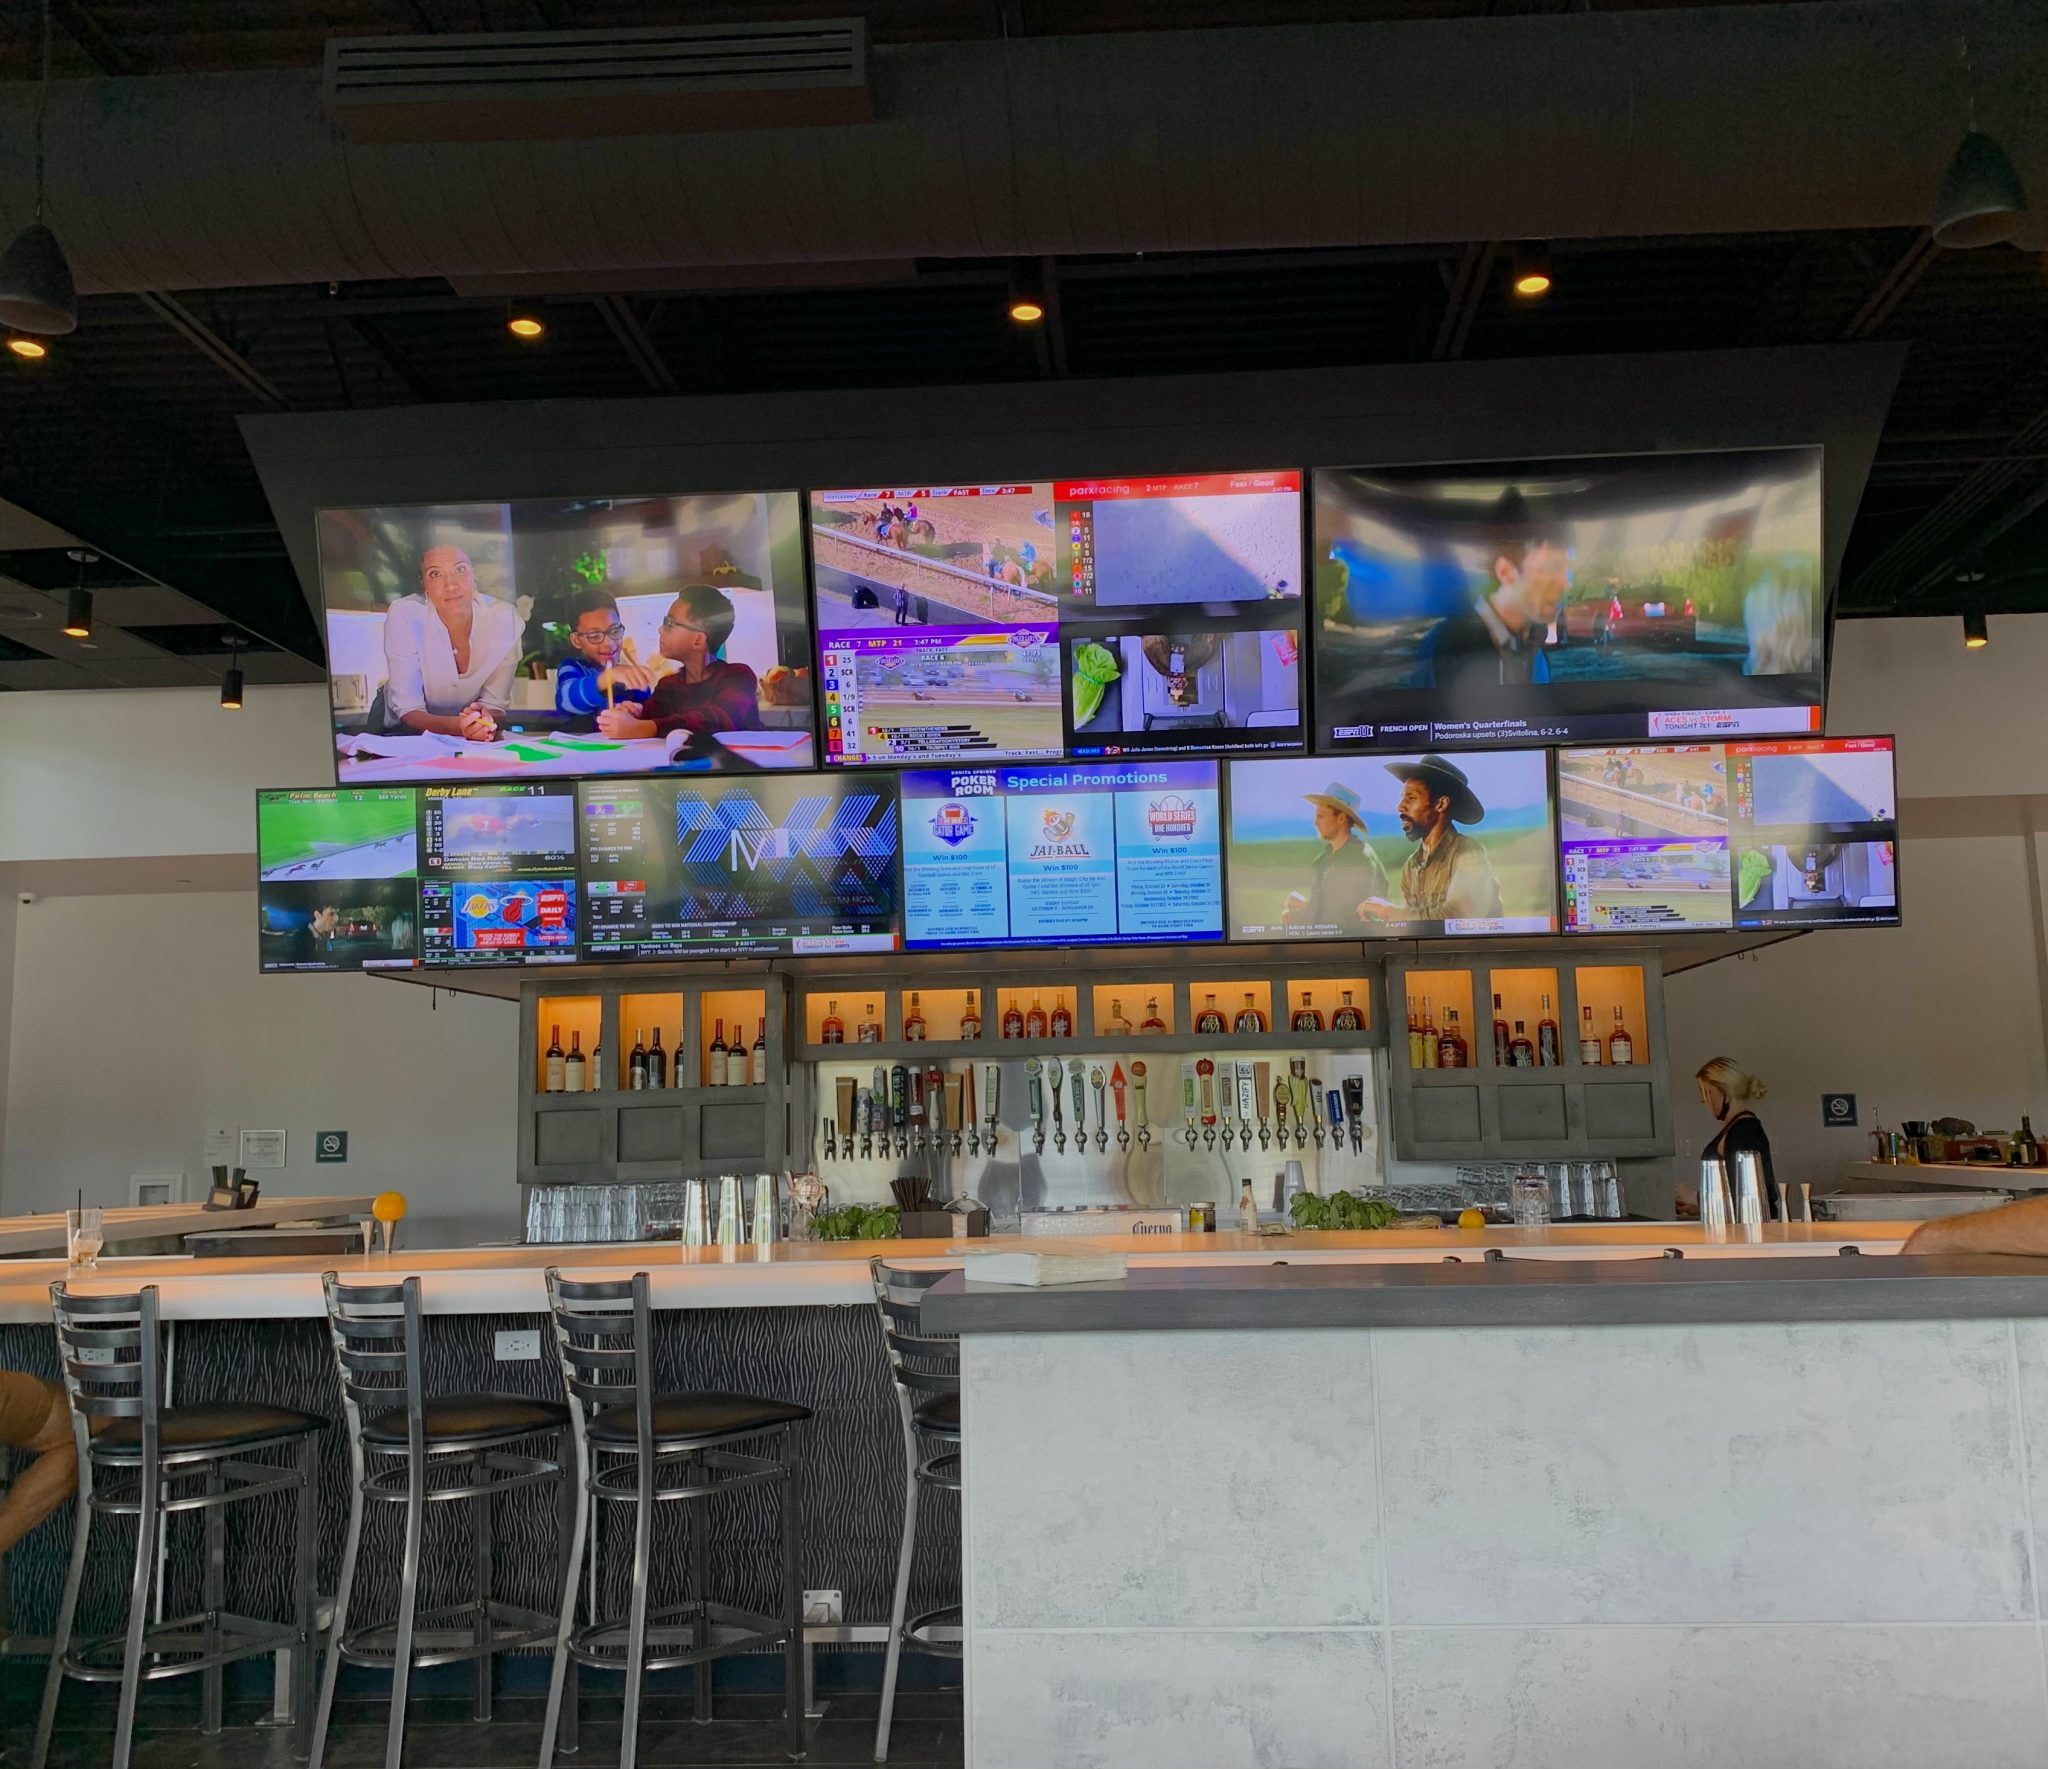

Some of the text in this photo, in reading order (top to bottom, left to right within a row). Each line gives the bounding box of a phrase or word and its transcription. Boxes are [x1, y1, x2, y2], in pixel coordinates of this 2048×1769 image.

[1069, 485, 1130, 496] parxracing
[1145, 484, 1151, 492] 2
[1253, 479, 1275, 487] Good
[828, 641, 851, 649] RACE
[856, 640, 862, 648] 7
[868, 640, 887, 648] MTP
[892, 639, 902, 647] 21
[827, 656, 835, 664] 1
[828, 669, 835, 677] 2
[829, 681, 836, 690] 3
[829, 693, 836, 702] 4
[831, 706, 837, 714] 5
[831, 717, 837, 726] 6
[1700, 715, 1732, 723] STORM
[1380, 725, 1407, 733] FRENCH
[1409, 724, 1428, 732] OPEN
[1434, 721, 1471, 730] Women's
[1472, 719, 1527, 730] Quarterfinals
[832, 730, 838, 738] 7
[1435, 731, 1471, 739] Podoroska
[1472, 731, 1496, 739] upsets
[1555, 727, 1568, 735] 6-4
[834, 754, 864, 762] CHANGES
[951, 776, 996, 788] POKER
[1007, 771, 1168, 791] Special Promotions
[425, 787, 450, 797] Derby
[451, 787, 473, 796] Lane
[528, 785, 545, 796] 11
[955, 785, 994, 796] ROOM
[1149, 810, 1195, 821] WORLD SERIES
[1155, 823, 1191, 832] ONE HUNDRED
[1030, 844, 1089, 857] JAI-BALL
[540, 894, 565, 902] ESPN
[540, 906, 564, 914] DAILY
[1242, 1081, 1250, 1109] HAZIFY
[1132, 1221, 1172, 1234] Cuervo
